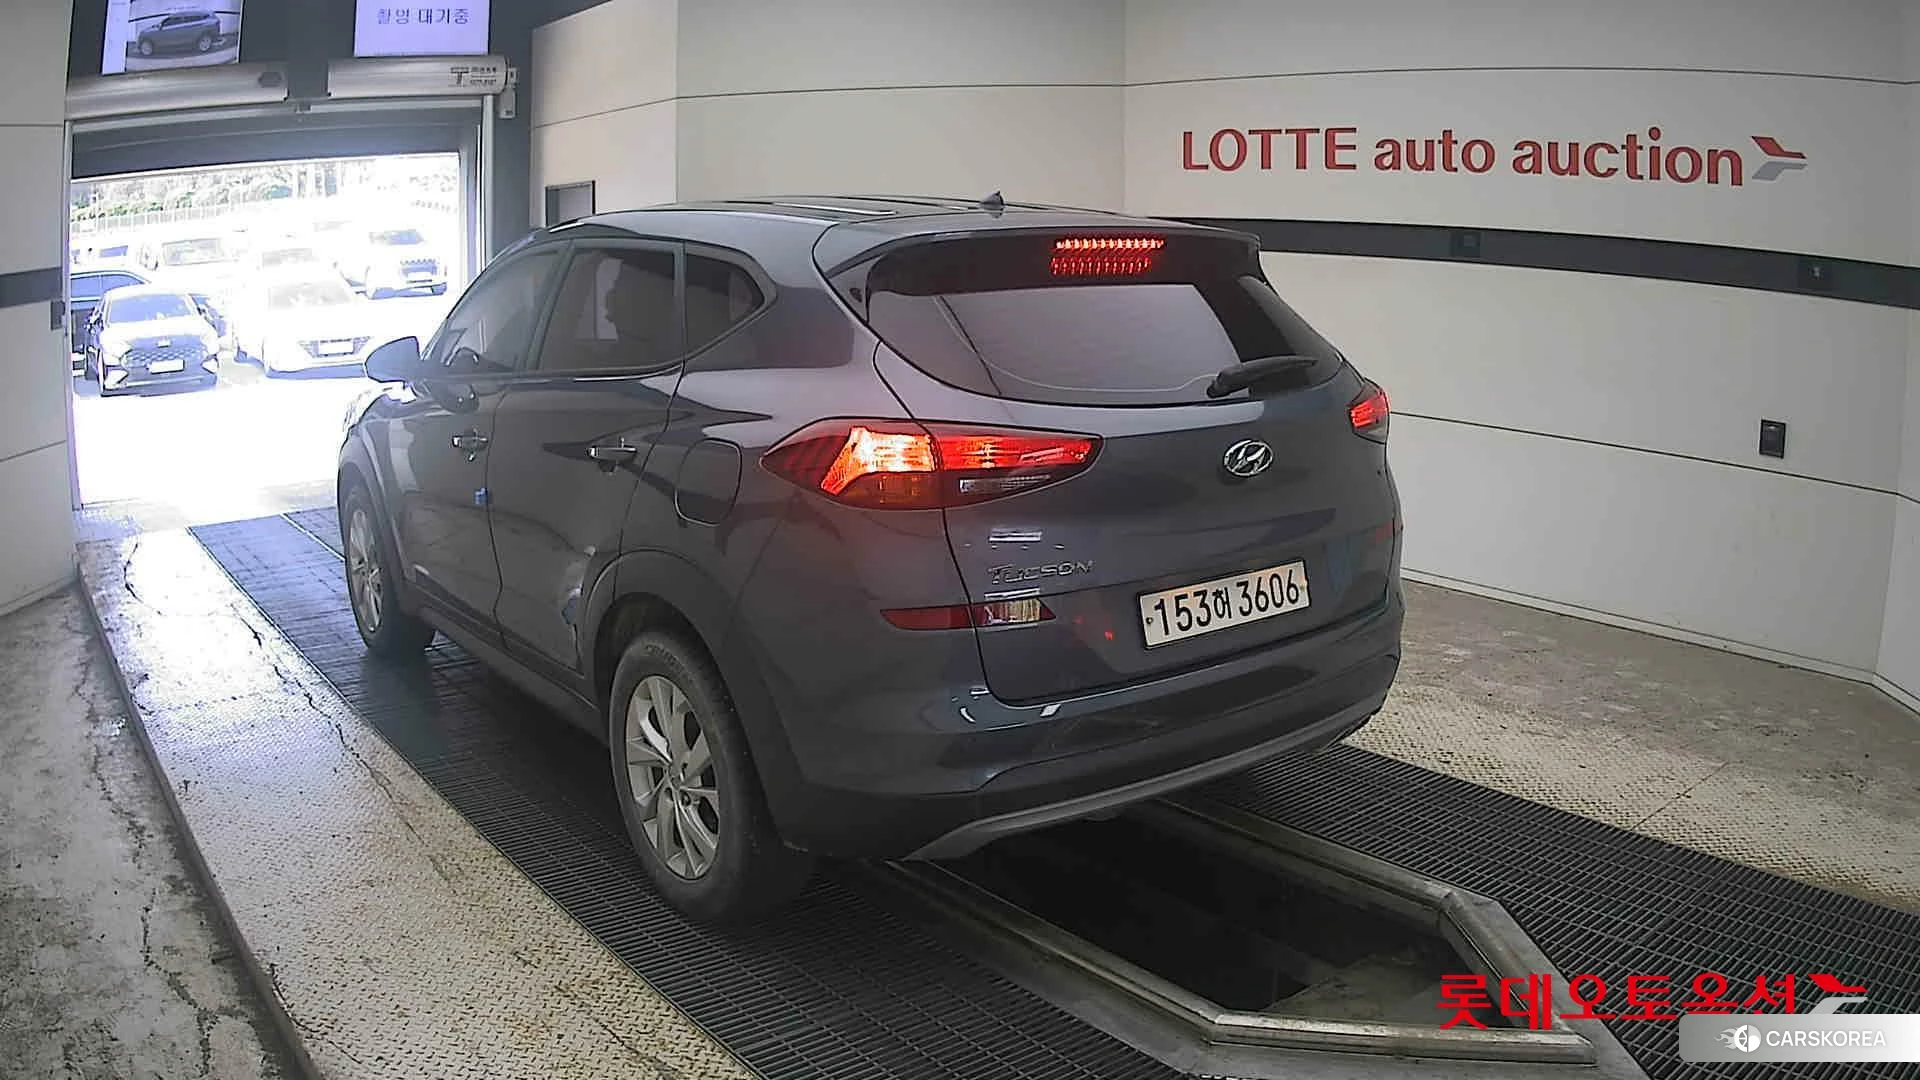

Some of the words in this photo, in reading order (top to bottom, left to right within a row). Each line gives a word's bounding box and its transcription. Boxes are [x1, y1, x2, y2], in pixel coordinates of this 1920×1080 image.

[418, 8, 469, 25] 대기중
[1182, 127, 1357, 171] LOTTE
[1374, 129, 1496, 173] auto
[1511, 126, 1743, 186] auction
[987, 560, 1094, 585] TUCSON
[1236, 568, 1300, 617] 3606
